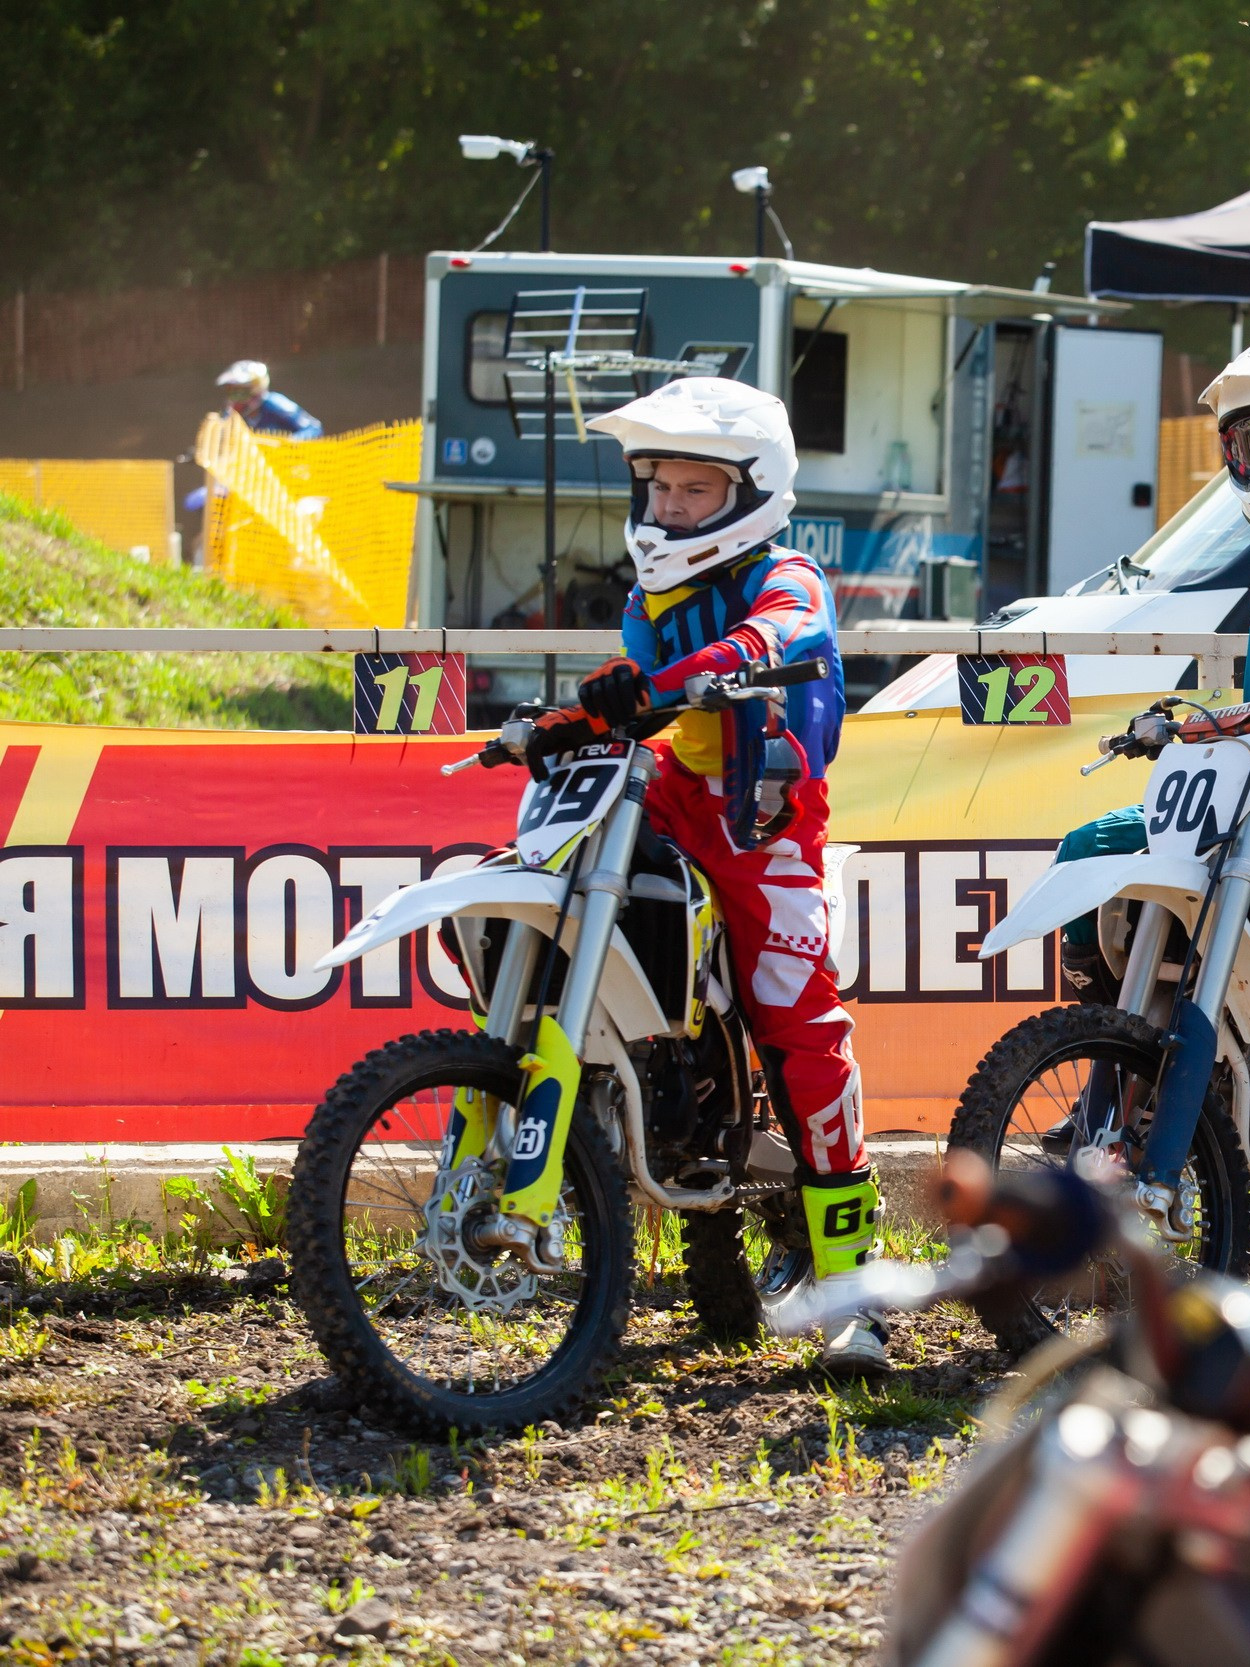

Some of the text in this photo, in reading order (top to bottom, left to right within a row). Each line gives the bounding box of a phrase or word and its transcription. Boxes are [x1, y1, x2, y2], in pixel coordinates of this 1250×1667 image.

[373, 664, 444, 732] 11
[977, 665, 1056, 723] 12
[518, 764, 620, 837] 89
[1149, 768, 1217, 836] 90
